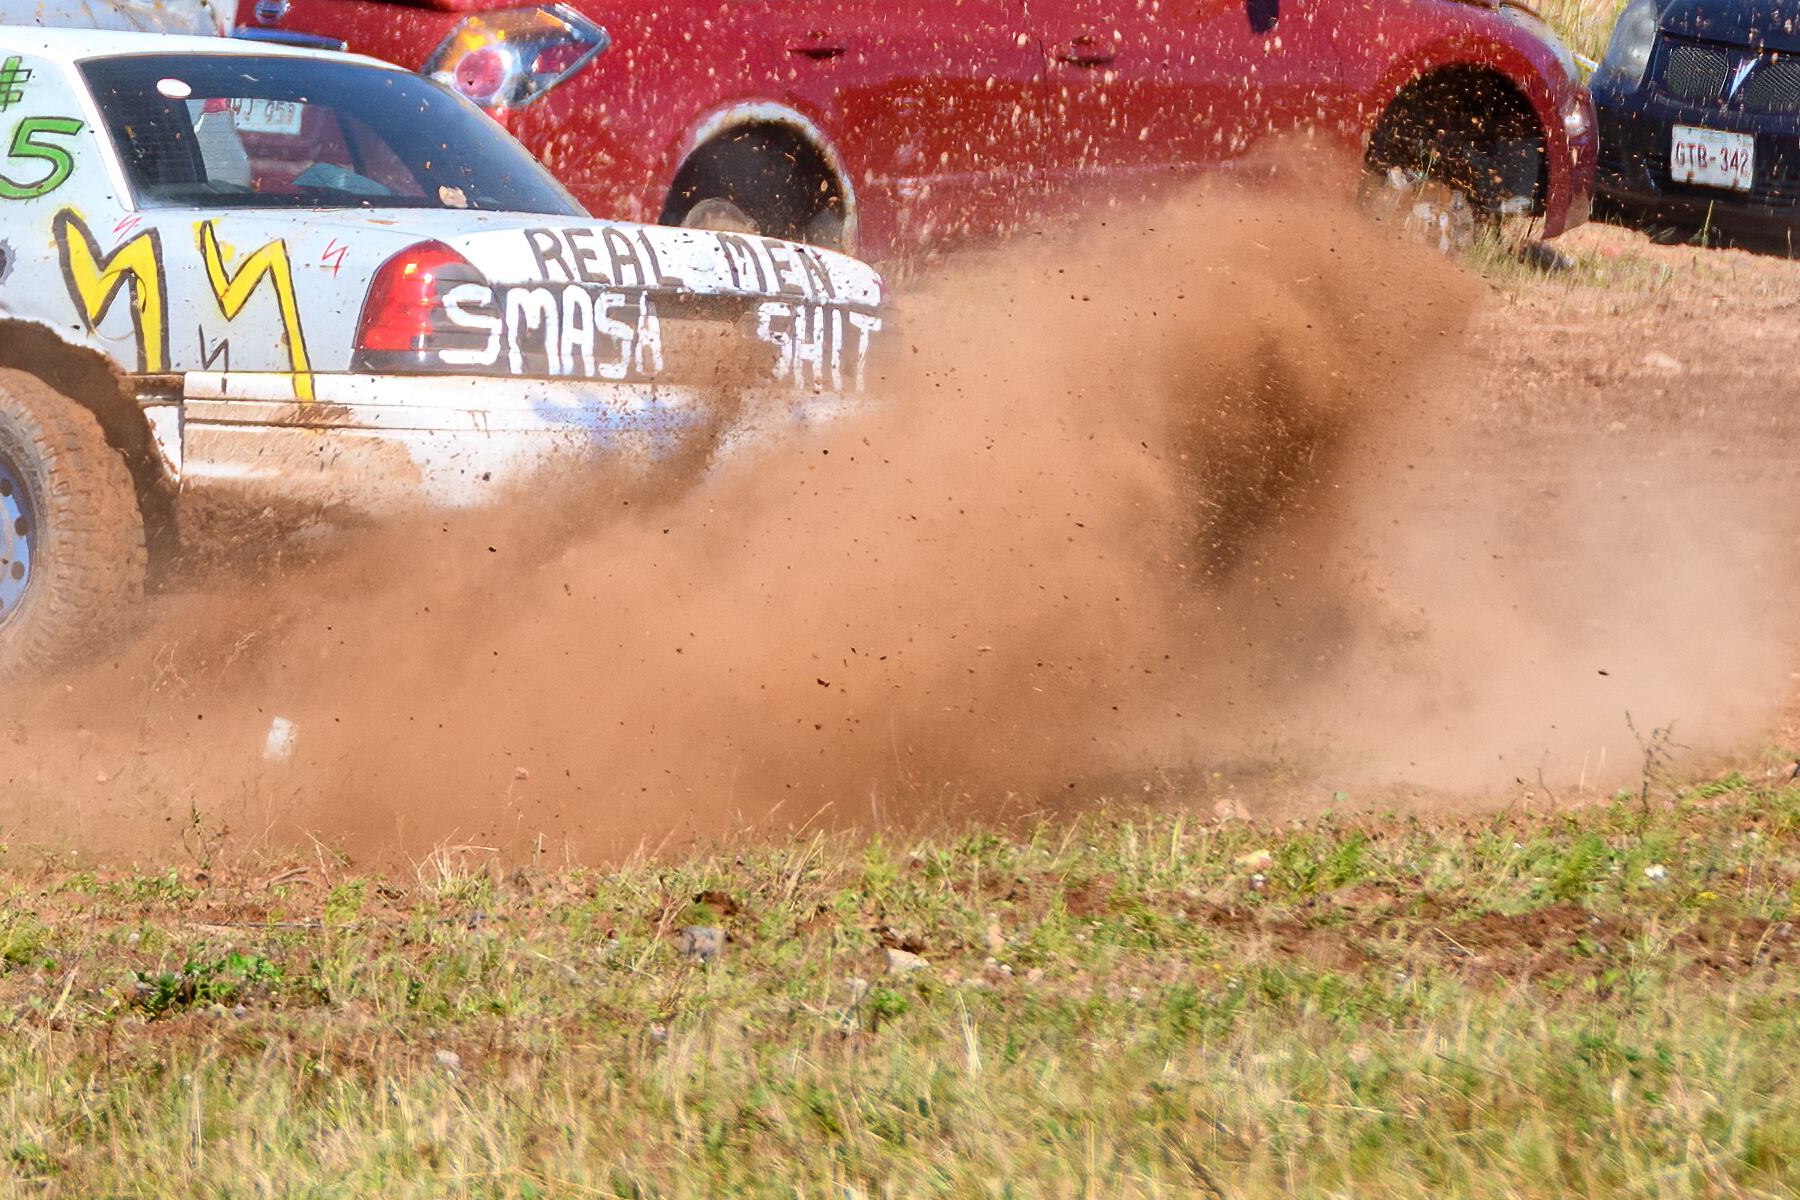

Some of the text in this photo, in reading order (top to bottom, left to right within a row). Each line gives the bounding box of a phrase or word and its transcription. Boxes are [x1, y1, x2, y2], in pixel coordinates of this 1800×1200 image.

[1675, 141, 1749, 177] GTB-342
[524, 228, 836, 299] REAL MEN
[756, 302, 883, 392] SHIT
